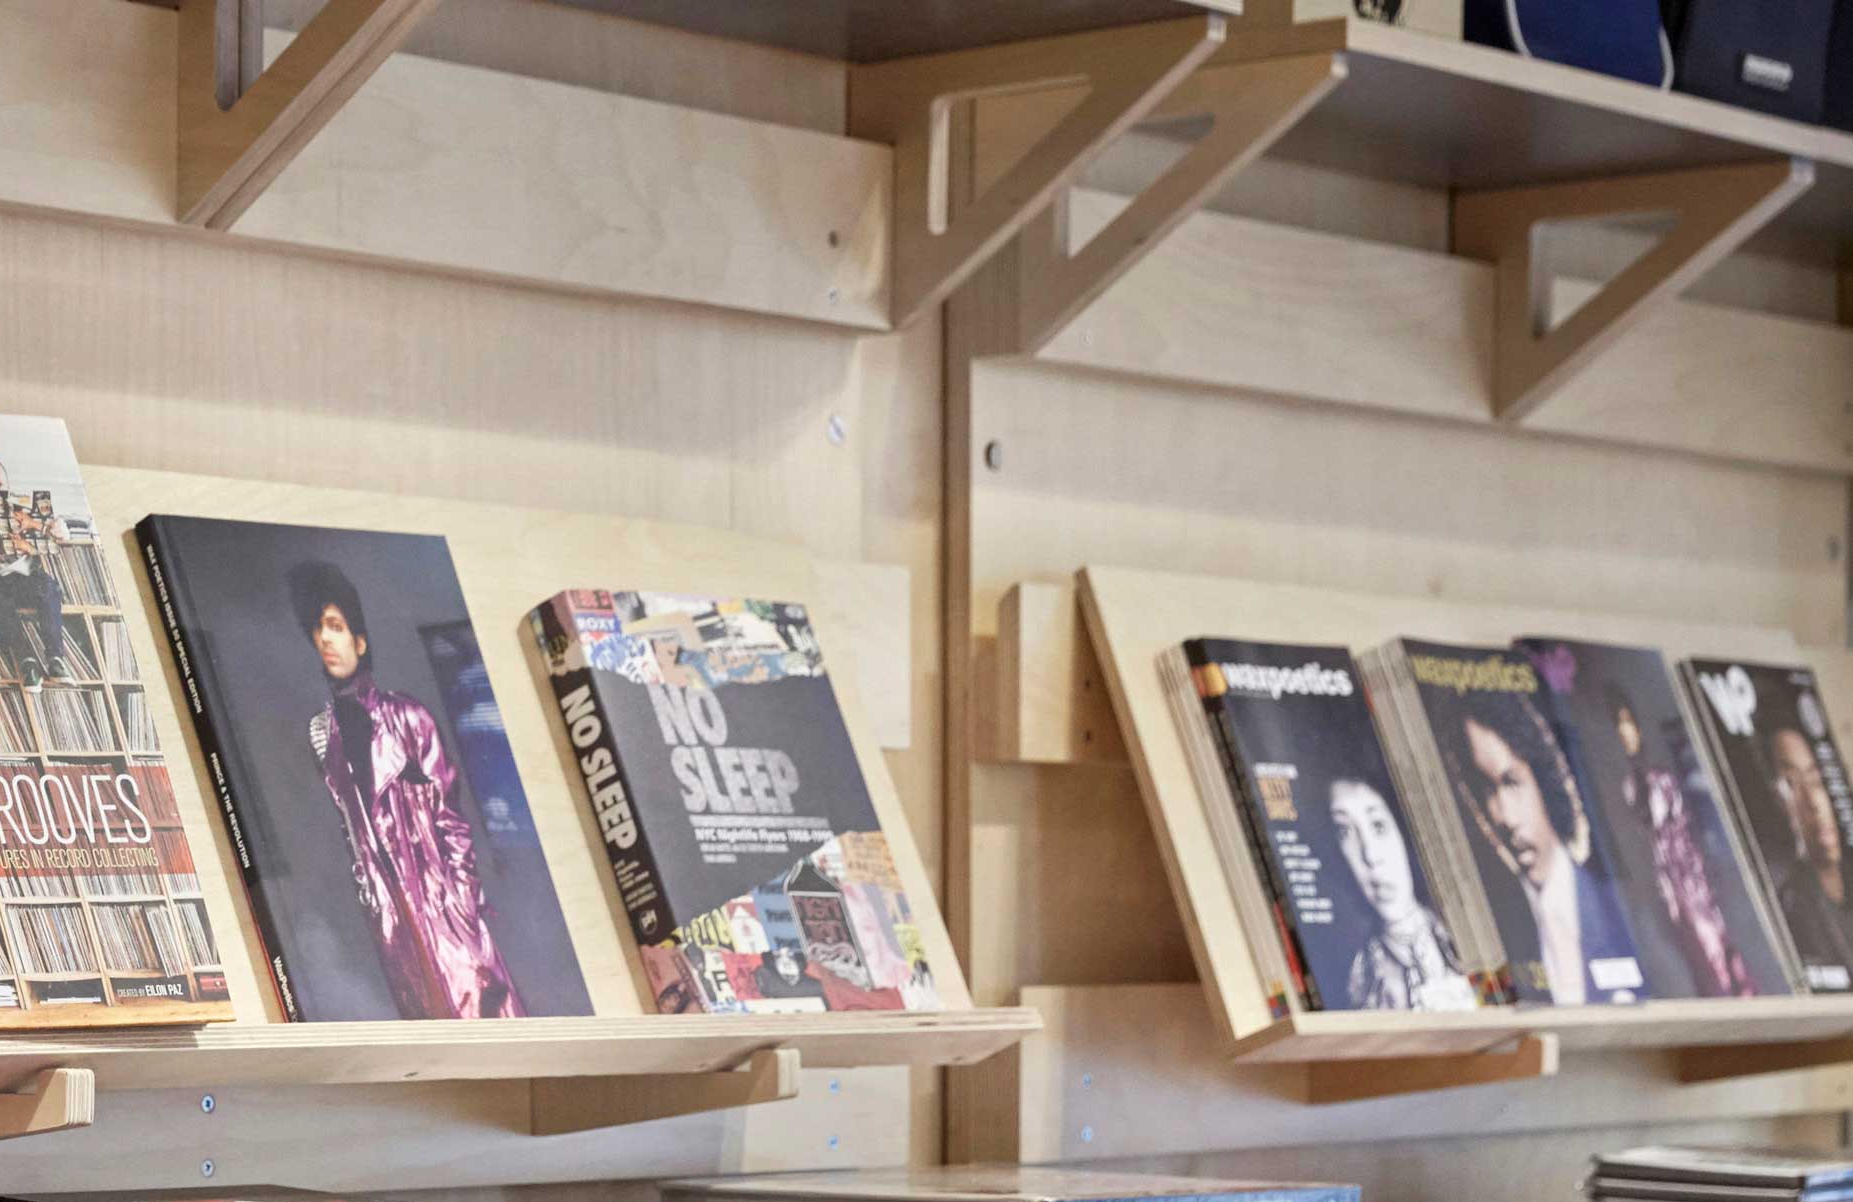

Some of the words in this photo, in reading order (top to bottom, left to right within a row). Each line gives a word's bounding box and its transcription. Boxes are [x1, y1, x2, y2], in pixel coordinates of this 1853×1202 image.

[153, 565, 168, 602] POETICS
[165, 603, 176, 627] ISSUE
[176, 641, 191, 677] SPECIAL
[187, 678, 202, 713] EDITION
[561, 685, 602, 748] NO
[646, 682, 728, 746] NO
[210, 752, 224, 784] PRINCE
[224, 793, 233, 812] THE
[229, 812, 250, 869] REVOLUTION
[581, 747, 637, 850] SLEEP
[670, 746, 800, 814] SLEEP
[32, 849, 44, 868] IN
[47, 848, 91, 868] RECORD
[93, 847, 158, 867] COLLECTING
[145, 985, 167, 996] EILON
[167, 984, 183, 995] PAZ
